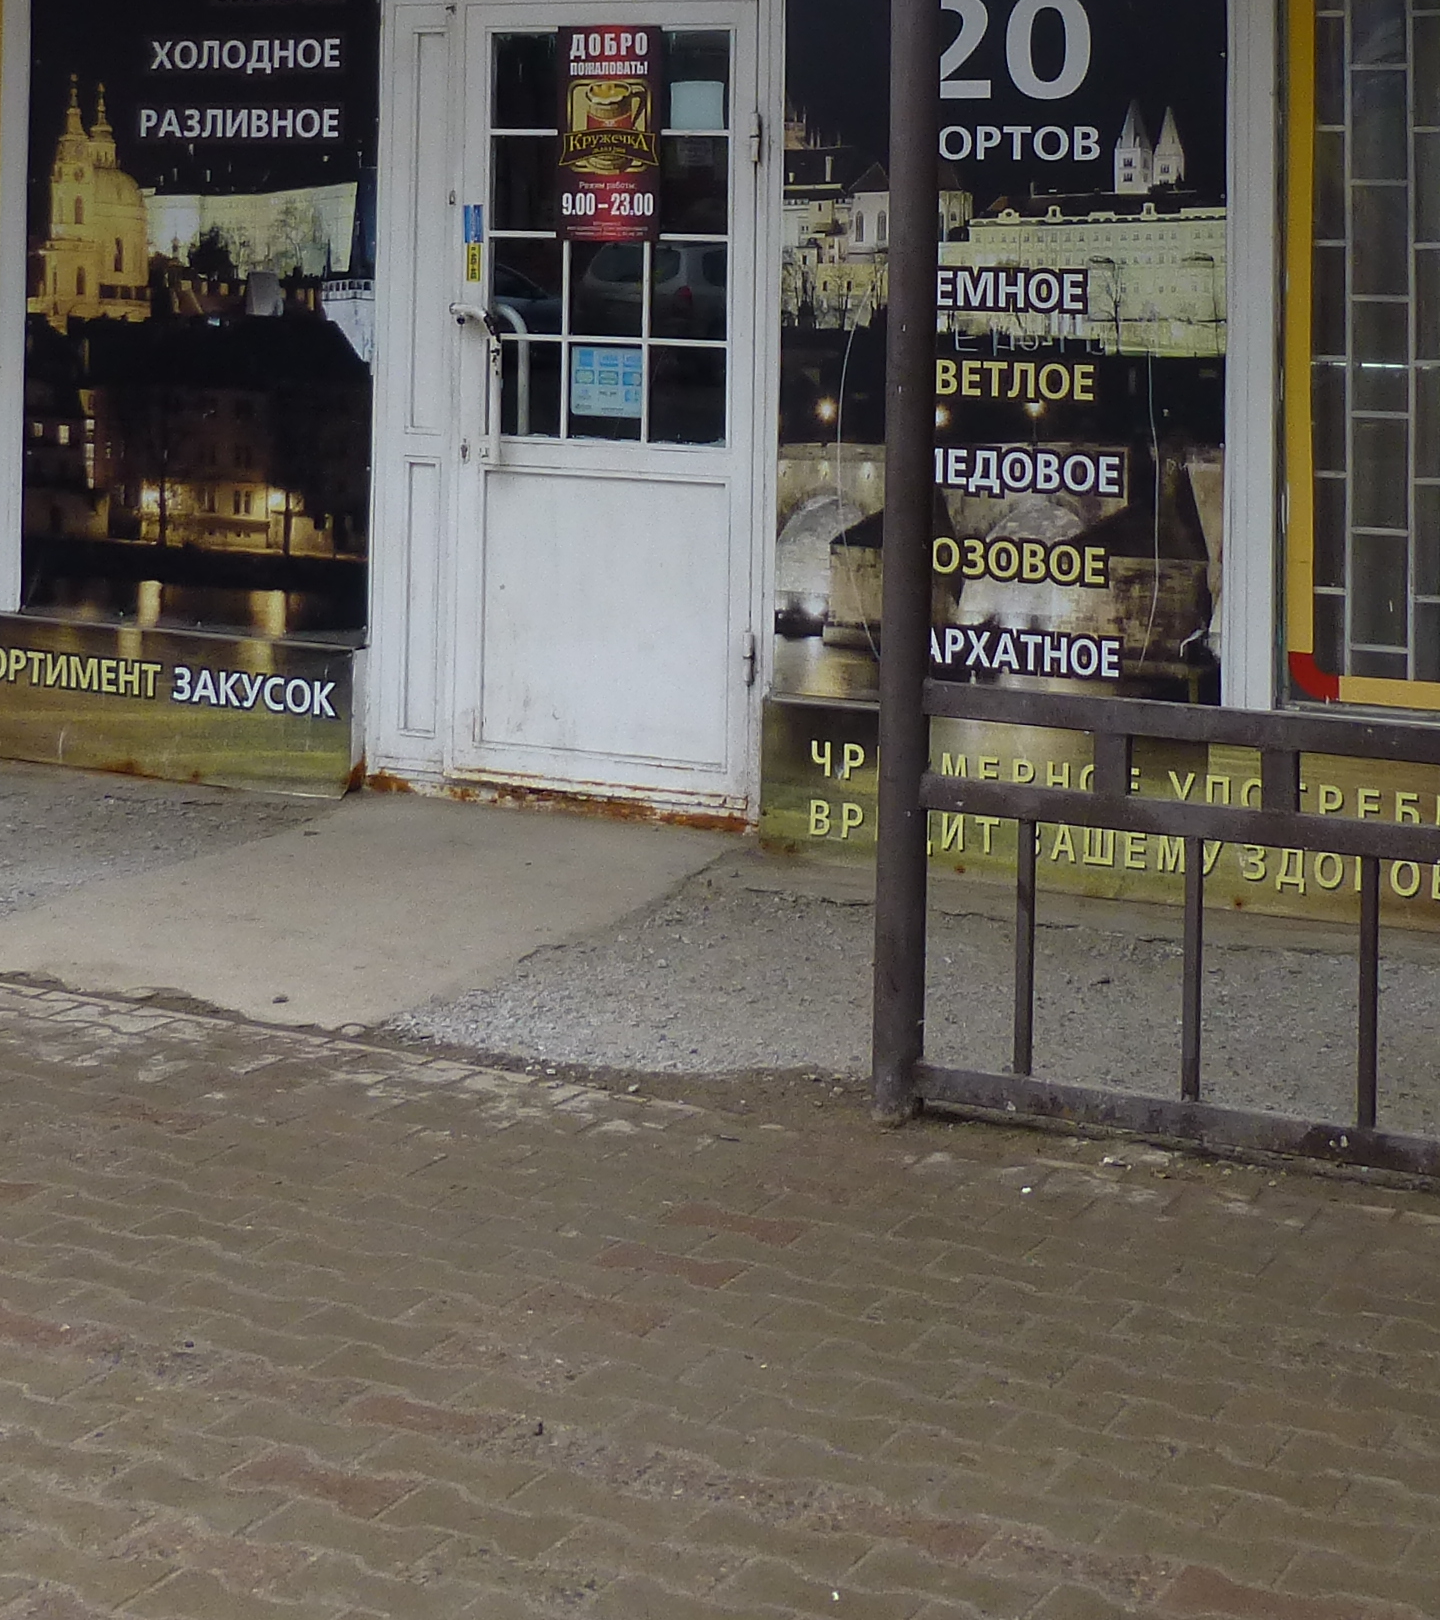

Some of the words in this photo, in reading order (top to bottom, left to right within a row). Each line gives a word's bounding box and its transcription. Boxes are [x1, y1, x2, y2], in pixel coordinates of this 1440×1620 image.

[150, 37, 341, 74] ХОЛОДНОЕ
[569, 32, 649, 60] ДОБРО
[569, 61, 649, 76] ПОЖАЛОВАТЬ!
[139, 107, 340, 139] РАЗЛИВНОЕ
[938, 125, 1101, 162] ОРТОВ
[936, 269, 1085, 310] ЕМНОЕ
[935, 358, 1095, 402] ВЕТЛОЕ
[934, 447, 1121, 494] ЕДОВОЕ
[932, 536, 1106, 585] ОЗОВОЕ
[930, 626, 1120, 678] АРХАТНОЕ
[172, 666, 338, 718] ЗАКУСОК
